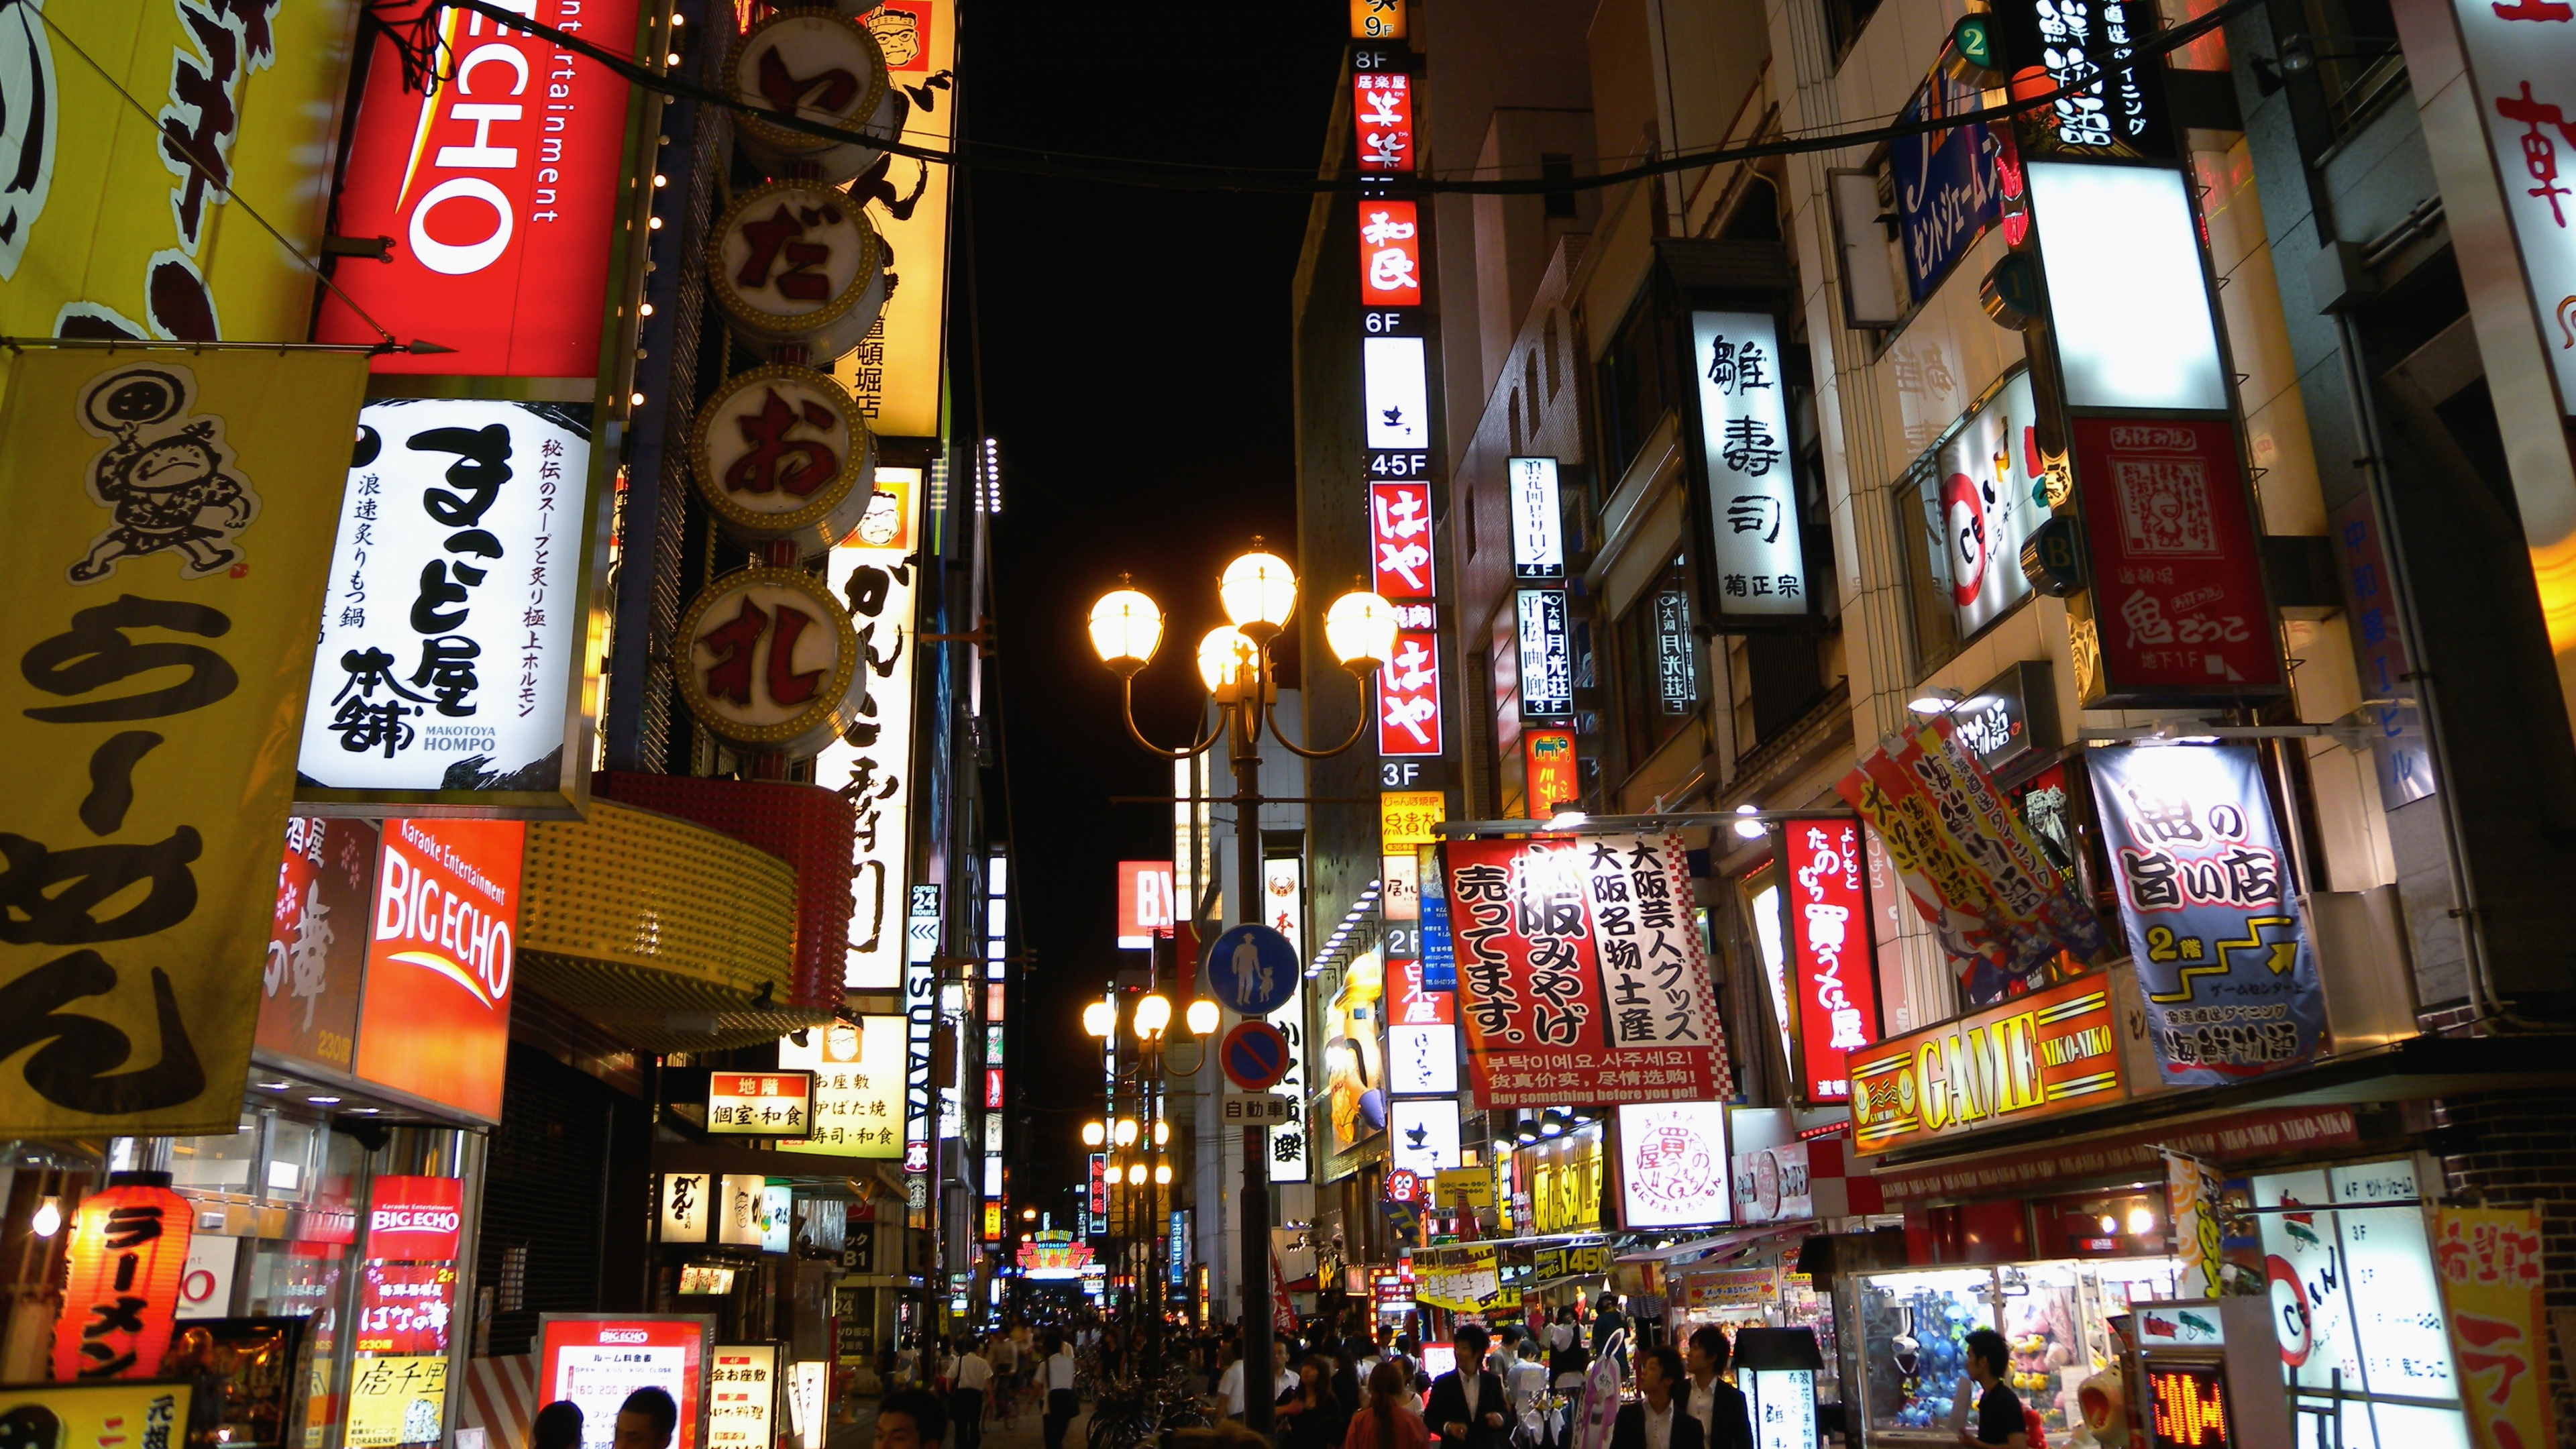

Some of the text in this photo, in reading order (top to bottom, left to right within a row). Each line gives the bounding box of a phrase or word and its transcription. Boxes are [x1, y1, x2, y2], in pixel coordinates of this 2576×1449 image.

[1364, 16, 1393, 37] 9F
[1964, 29, 1985, 56] 2
[1356, 52, 1387, 68] 8F
[1358, 76, 1406, 89] 居楽屋
[1362, 211, 1418, 290] 和民
[1365, 313, 1400, 333] 6F
[338, 473, 382, 629] 浪速炙りもつ鍋
[1375, 490, 1430, 590] はや
[1725, 574, 1800, 598] 菊正宗
[1521, 594, 1546, 698] 平松画廊
[425, 726, 496, 737] MAKOTOYA
[424, 737, 496, 752] HOMPO
[1383, 763, 1419, 786] 3F
[401, 818, 506, 906] Karaoke Entertainment
[1839, 827, 1860, 890] よしもと
[2123, 847, 2280, 908] 旨い店
[912, 885, 938, 894] OPEN
[912, 894, 937, 910] 24
[912, 908, 937, 916] hours
[376, 844, 512, 1000] BIG ECHO
[1588, 842, 1658, 1041] 大阪名物土産
[1628, 841, 1699, 1041] 大阪芸人グッズ
[2146, 926, 2204, 964] 2階
[2041, 1024, 2113, 1069] NIKO-NIKO
[1915, 1010, 2045, 1130] GAME
[738, 1077, 779, 1096] 地階
[1491, 1084, 1698, 1106] Buy something before you go!!
[712, 1105, 804, 1126] 個室・和食
[1225, 1100, 1284, 1118] 自動車
[812, 1126, 894, 1146] 寿司・和食
[2282, 1110, 2350, 1141] NIKO-NIKO
[907, 1143, 928, 1169] 本
[371, 1210, 460, 1232] BIG ECHO
[2352, 1225, 2367, 1241] 3F
[843, 1250, 866, 1267] B1
[2438, 1220, 2542, 1290] 希望軒
[437, 1268, 454, 1283] 2F
[79, 1207, 163, 1379] ラーメン
[350, 1436, 397, 1446] TORASENRI
